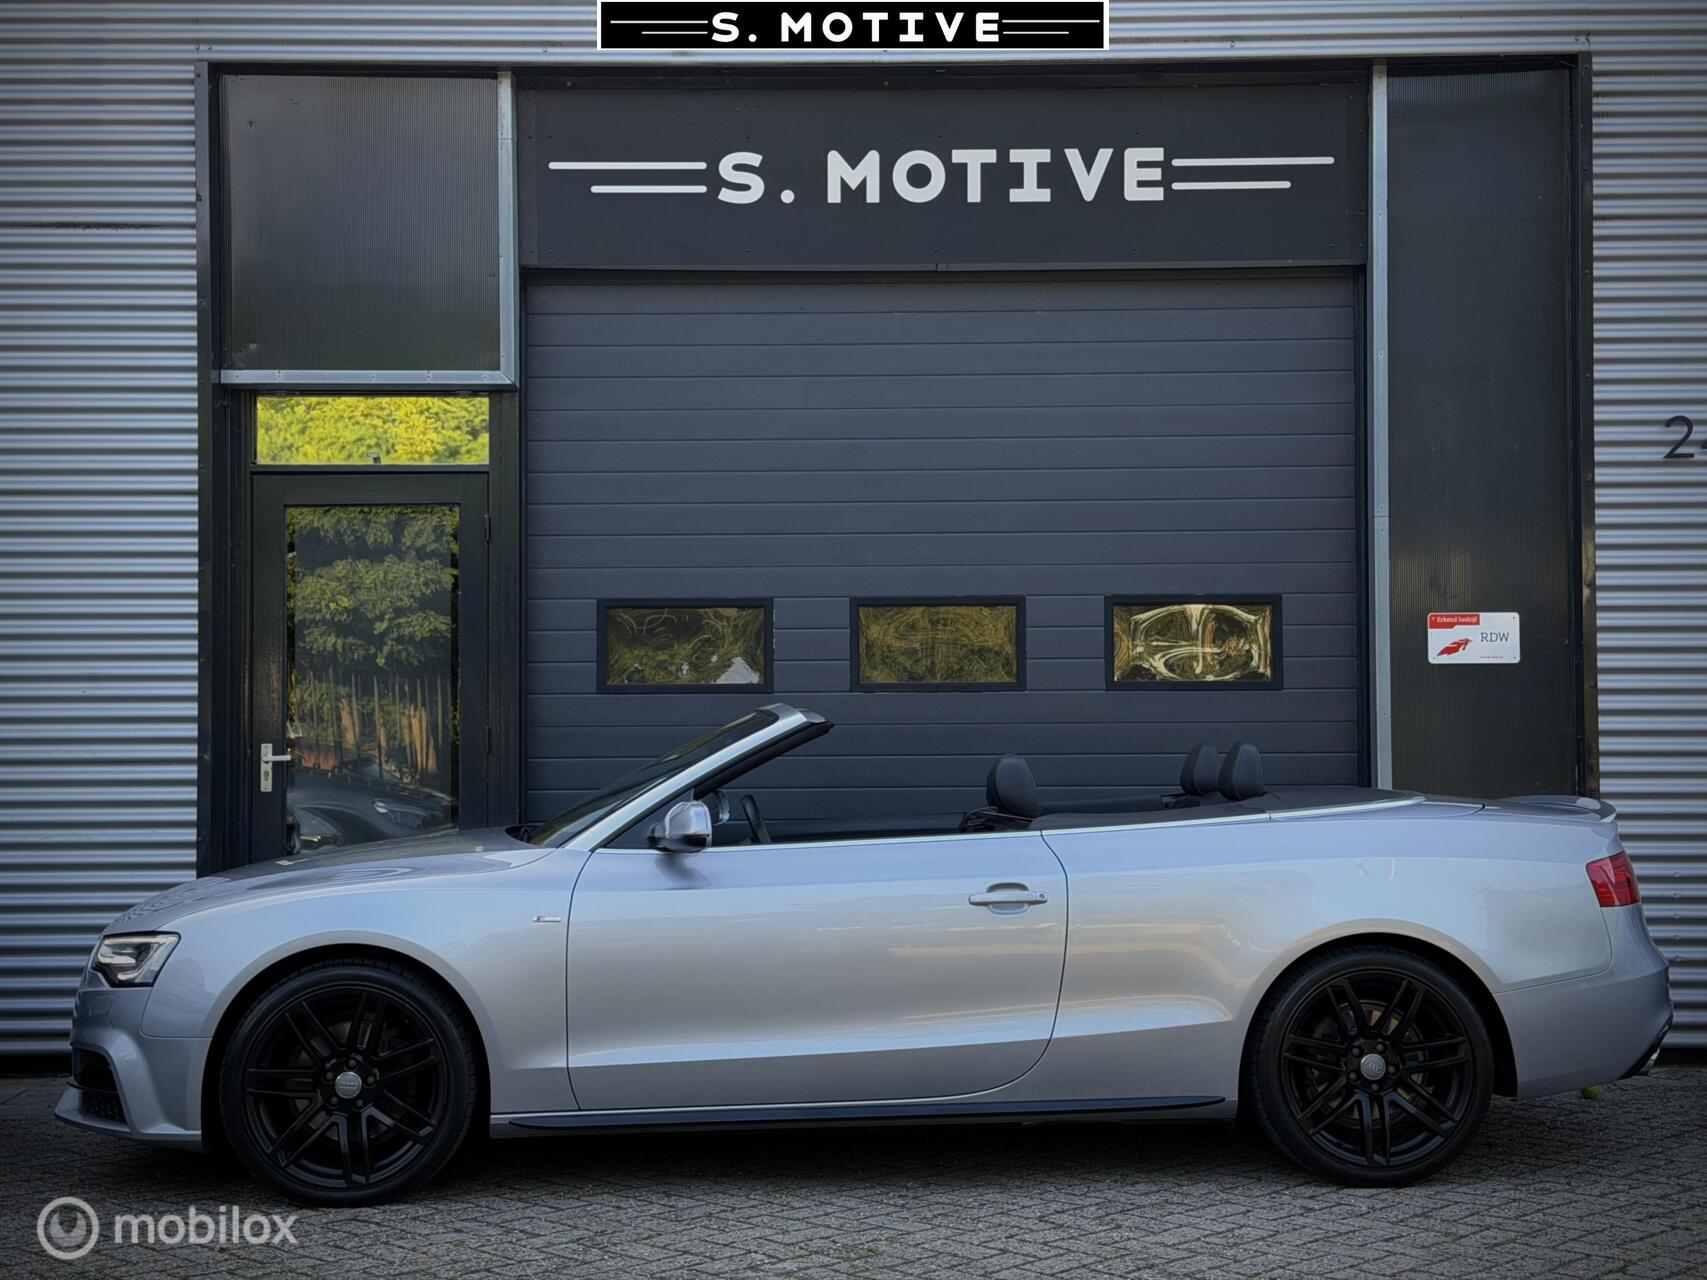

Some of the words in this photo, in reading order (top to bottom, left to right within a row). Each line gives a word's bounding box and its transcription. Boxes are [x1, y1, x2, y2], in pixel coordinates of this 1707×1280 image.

[717, 151, 795, 205] S.
[827, 148, 1165, 204] MOTIVE
[1664, 415, 1707, 459] 2
[1480, 632, 1510, 643] RDW
